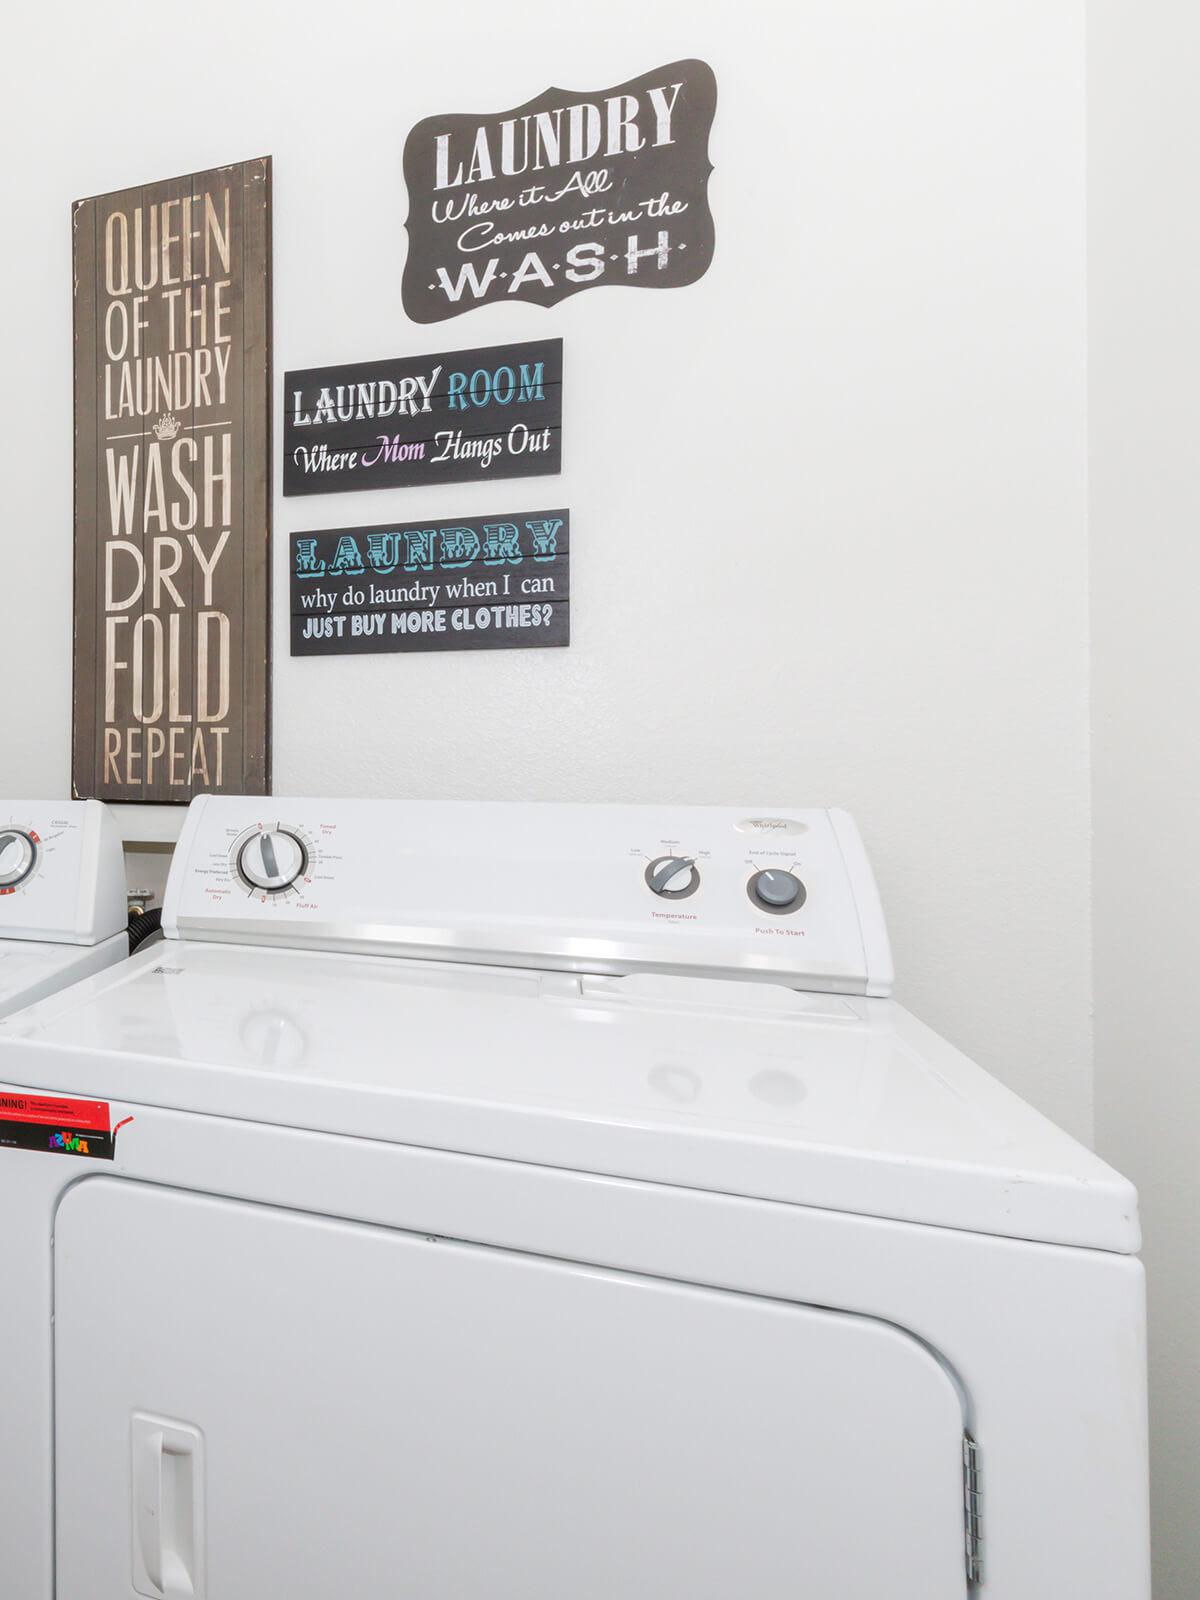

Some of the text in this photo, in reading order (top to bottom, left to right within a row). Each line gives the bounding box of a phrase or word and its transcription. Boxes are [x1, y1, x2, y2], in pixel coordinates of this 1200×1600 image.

[433, 83, 683, 190] LAUNDRY
[432, 169, 613, 223] Where it All
[456, 191, 689, 253] Comes out in the
[105, 187, 231, 296] QUEEN
[434, 230, 673, 302] WASH
[105, 280, 231, 361] OF THE
[105, 344, 232, 420] LAUNDRY
[293, 362, 546, 427] LAUNDRY ROOM
[293, 423, 552, 474] Where Mom Hangs Out
[106, 433, 232, 536] WASH
[105, 530, 231, 612] DRY
[296, 518, 563, 579] LAUNDRY
[300, 574, 555, 613] why do laundry when I can
[302, 604, 553, 639] JUST BUY MORE CLOTHES?
[104, 611, 231, 725] FOLD
[103, 726, 230, 787] REPEAT
[651, 911, 698, 920] Temperature
[785, 929, 806, 937] Start
